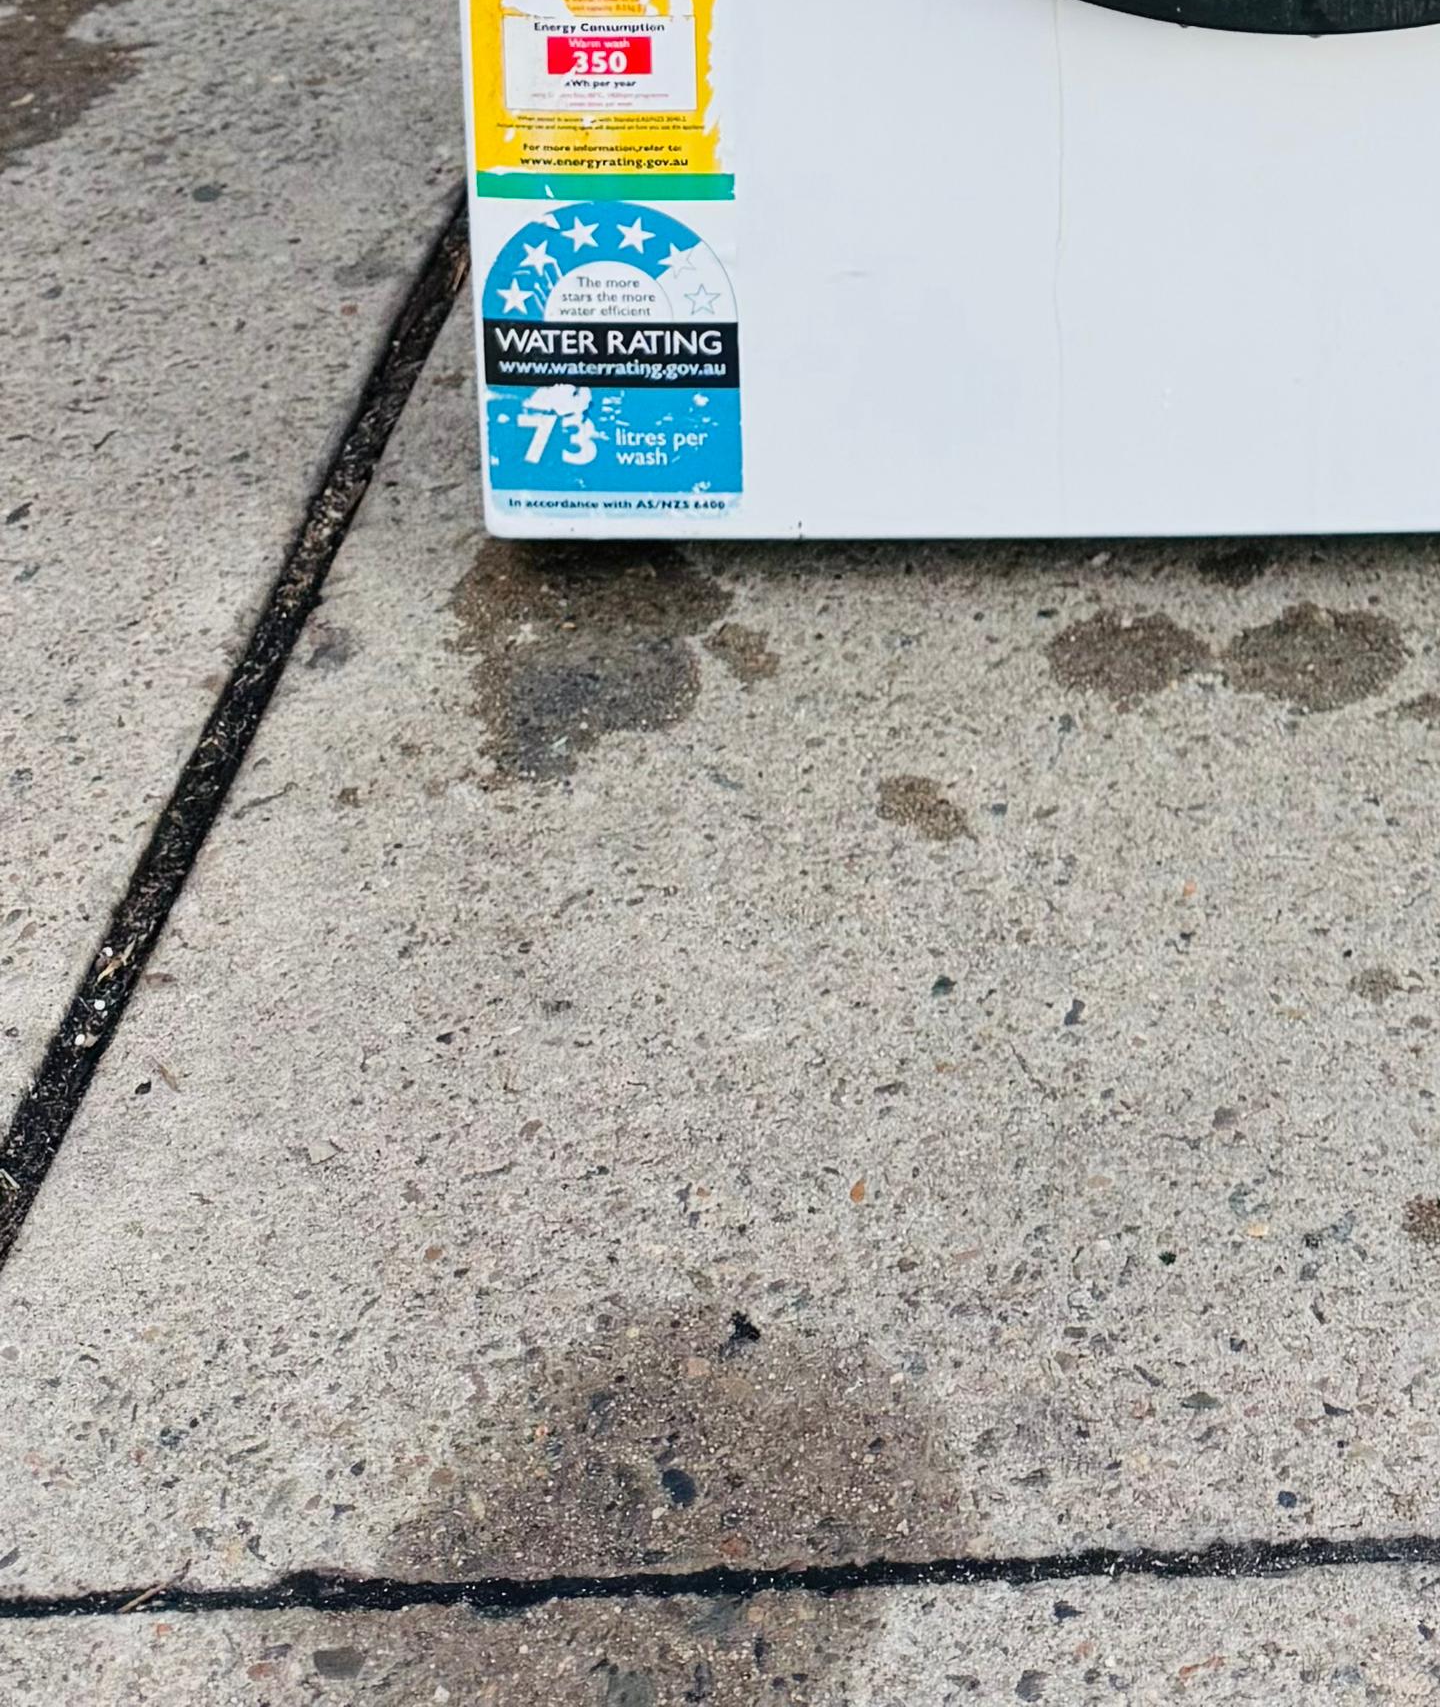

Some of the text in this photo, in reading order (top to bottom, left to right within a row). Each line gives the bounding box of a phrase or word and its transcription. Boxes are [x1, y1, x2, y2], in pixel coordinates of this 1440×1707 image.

[533, 21, 665, 33] Energy Consumption
[569, 39, 631, 48] Warm wash
[571, 50, 628, 74] 350
[593, 80, 611, 90] per
[614, 80, 637, 89] year
[522, 143, 540, 152] For
[543, 144, 571, 152] more
[519, 157, 689, 169] www.energyrating.gov.au
[576, 276, 640, 288] The more
[562, 292, 656, 303] stars the more
[559, 305, 651, 317] water efficient
[494, 327, 723, 356] WATER RATING
[498, 359, 727, 380] www.waterrating.gov.au
[516, 413, 598, 466] 73
[615, 427, 709, 451] litres per
[616, 449, 668, 467] wash
[508, 498, 522, 508] In
[525, 498, 600, 509] accordance
[602, 499, 633, 509] with
[636, 500, 690, 510] AS/NZS
